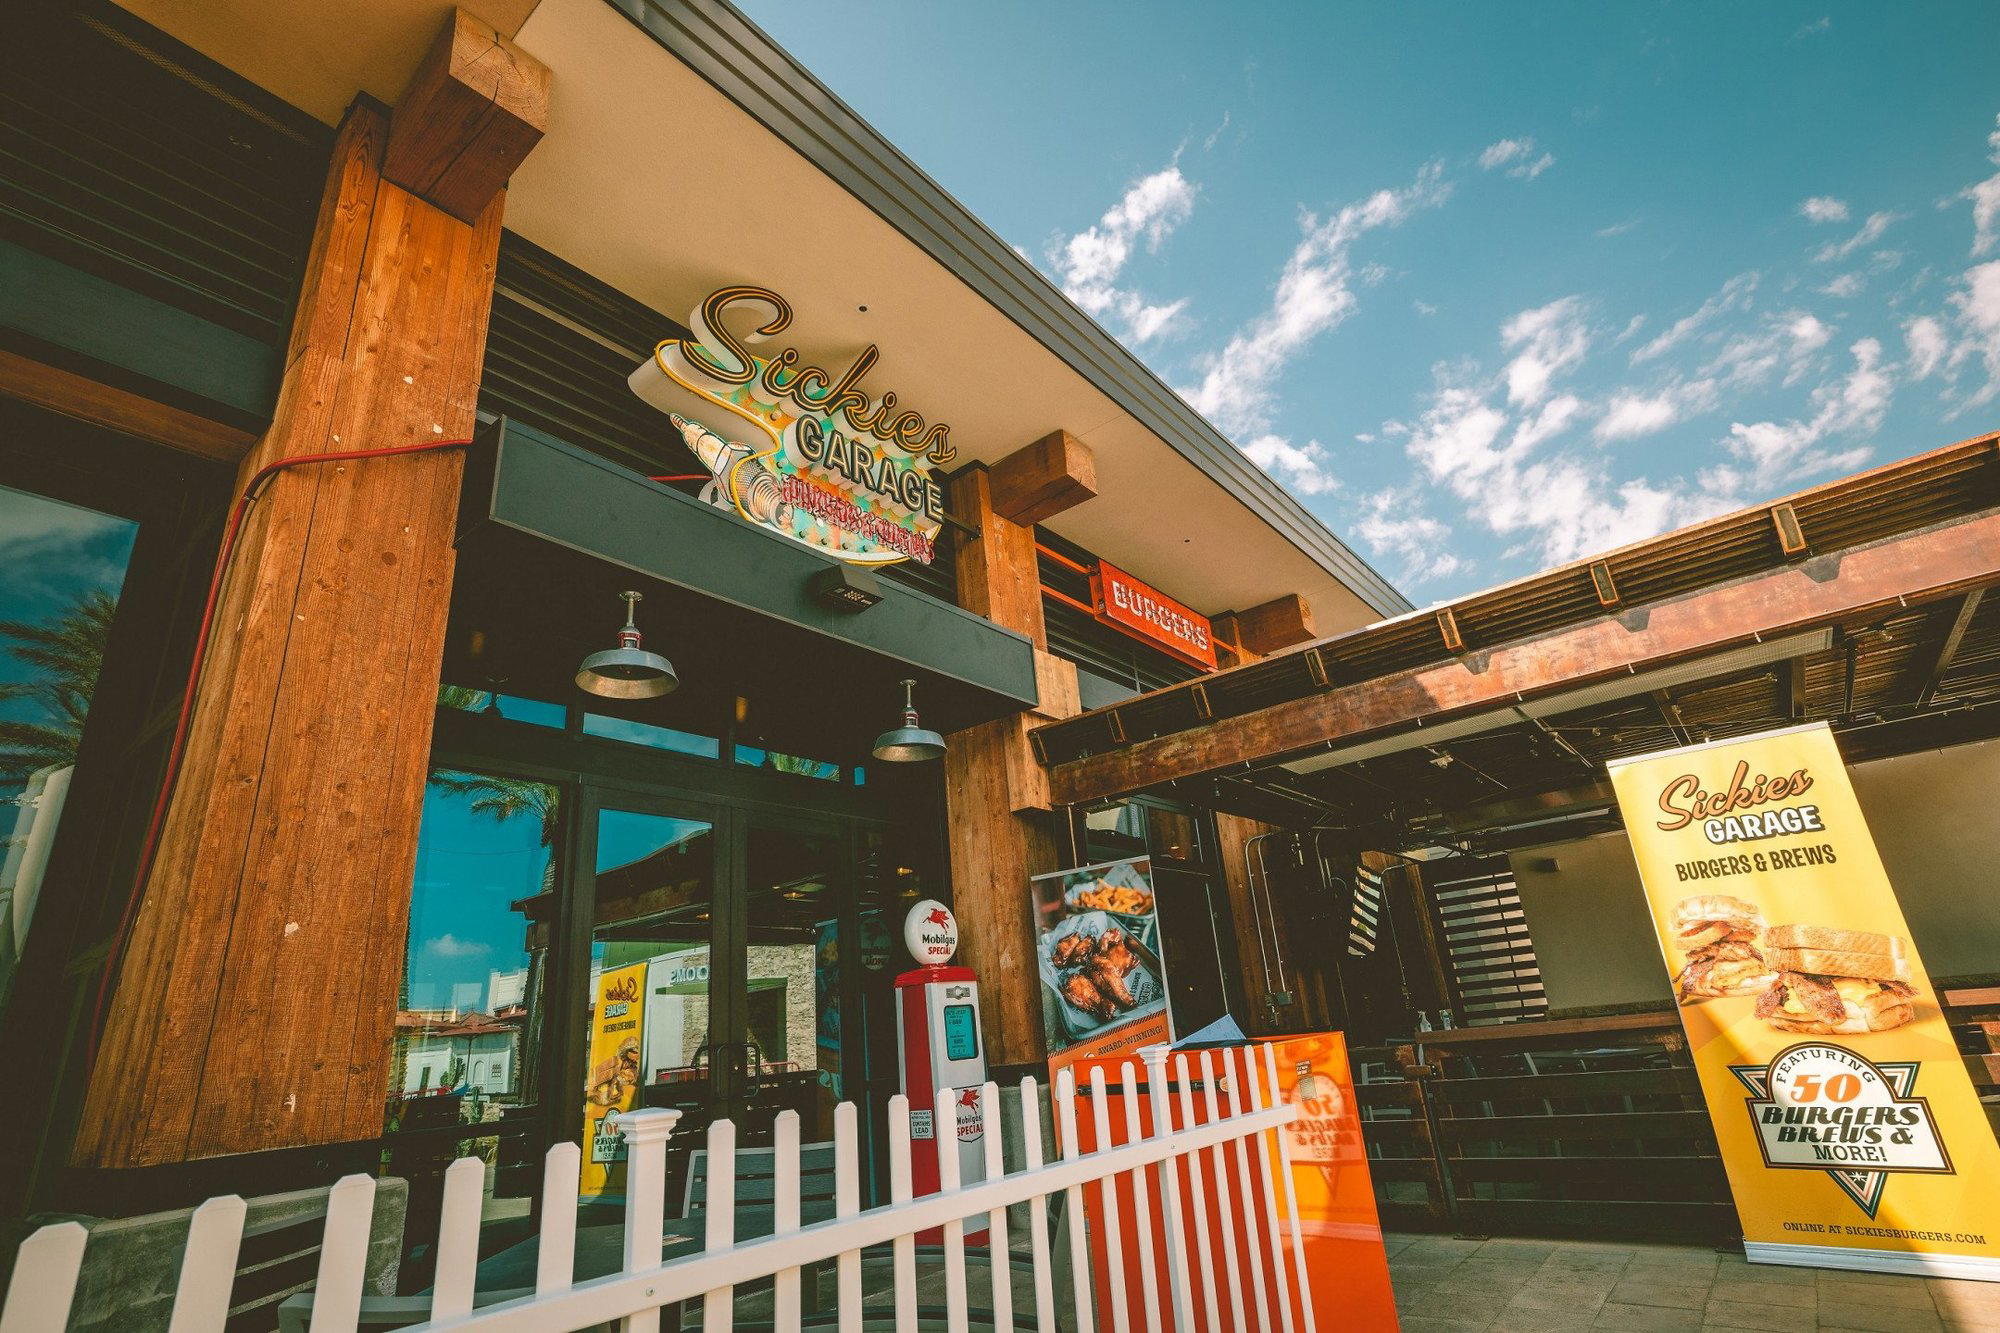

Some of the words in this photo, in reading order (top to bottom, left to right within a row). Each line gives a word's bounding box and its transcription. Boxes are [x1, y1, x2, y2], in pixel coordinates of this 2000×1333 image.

[679, 286, 956, 464] Sickies
[796, 414, 945, 522] GARAGE
[1112, 580, 1208, 650] BURGERS
[1657, 760, 1814, 831] Sickies
[1704, 805, 1826, 845] GARAGE
[1675, 854, 1751, 882] BURGERS
[1753, 853, 1767, 872] &
[1769, 844, 1837, 871] BREWS
[922, 934, 956, 946] Mobilgas
[928, 946, 951, 955] SPECIAL
[1098, 1025, 1164, 1056] AWARD-WINNING!
[1777, 1049, 1876, 1084] FEATURING
[1790, 1073, 1862, 1103] 50
[956, 1115, 983, 1126] Mobilgas
[1761, 1106, 1920, 1126] BURGERS
[1777, 1124, 1883, 1144] BREWS
[1890, 1127, 1914, 1145] &
[1812, 1144, 1888, 1162] MORE!
[1783, 1221, 1825, 1233] ONLINE
[1829, 1224, 1842, 1234] AT
[1845, 1225, 1987, 1245] SICKIESBURGERS.COM
